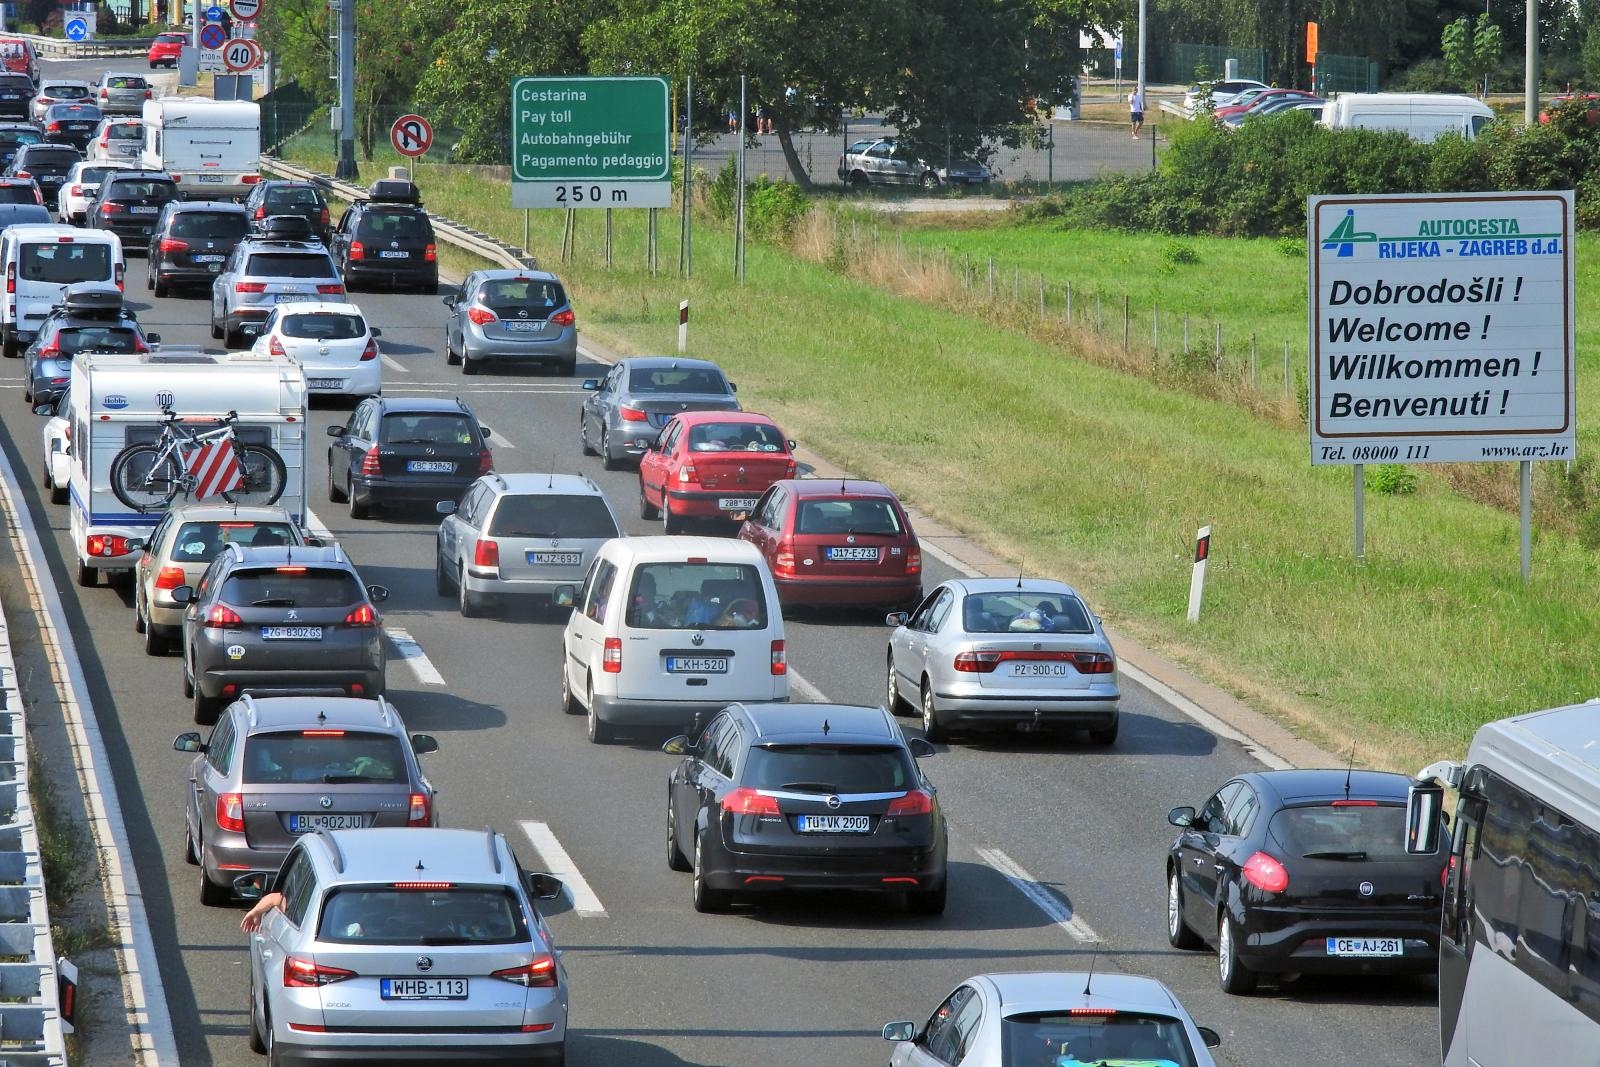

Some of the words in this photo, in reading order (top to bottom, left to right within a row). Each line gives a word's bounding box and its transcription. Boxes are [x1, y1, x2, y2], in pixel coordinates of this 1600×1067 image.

[230, 47, 249, 64] 40
[521, 89, 587, 102] Cestarina
[521, 111, 547, 125] Pay
[550, 111, 572, 123] toll
[521, 132, 632, 147] Autobahngebühr
[522, 154, 598, 169] Pagamento
[602, 154, 663, 168] pedaggio
[612, 189, 628, 202] m
[1418, 218, 1520, 236] AUTOCESTA
[1379, 242, 1441, 258] RIJEKA
[1459, 240, 1528, 256] ZAGREB
[1532, 239, 1563, 255] d.d.
[1329, 277, 1504, 306] Dobrodošli
[1328, 317, 1471, 342] Welcome
[1328, 354, 1521, 380] Willkommen
[156, 394, 173, 406] 100
[1330, 390, 1491, 418] Benvenuti
[1321, 447, 1346, 460] Tel.
[1352, 446, 1399, 460] 08000
[1406, 445, 1431, 459] 111
[1482, 442, 1569, 458] www.arz.hr
[536, 555, 578, 563] MJZ-693
[833, 549, 877, 558] J17-E-733
[270, 628, 280, 637] ZG
[231, 647, 241, 655] HR
[675, 658, 724, 670] LKH-520
[1015, 665, 1026, 674] PZ
[300, 816, 314, 829] BL
[321, 816, 361, 829] 902JU
[806, 816, 820, 828] TÜ
[827, 817, 840, 828] VK
[843, 817, 868, 829] 2909
[1339, 940, 1353, 951] CE
[1363, 940, 1399, 952] AJ-261
[394, 981, 463, 994] WHB-113
